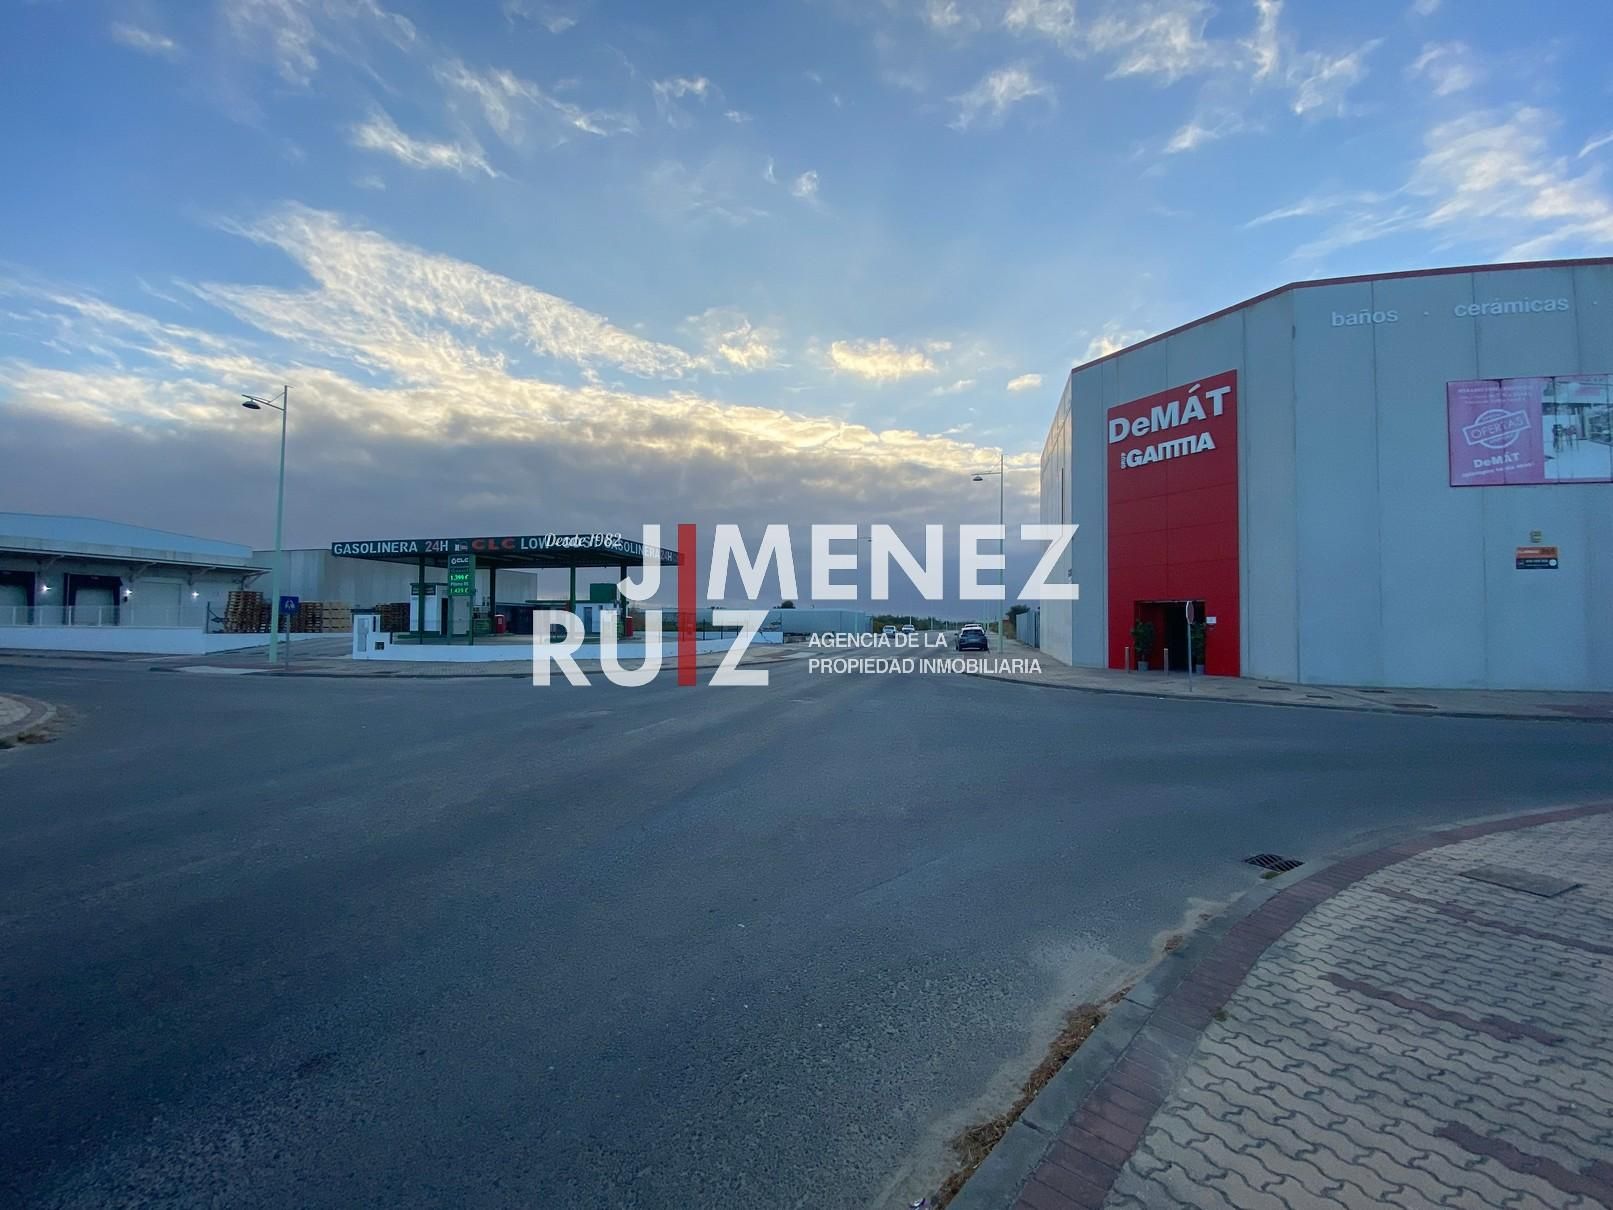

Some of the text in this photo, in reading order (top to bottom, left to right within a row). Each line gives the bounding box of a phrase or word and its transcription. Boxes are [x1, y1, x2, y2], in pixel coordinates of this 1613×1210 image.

[1331, 296, 1569, 327] baños cerámicas
[1109, 383, 1232, 443] DeMÁT
[1471, 415, 1524, 439] OFERTAS
[333, 541, 418, 555] GASOLINERA
[425, 540, 449, 552] 24H
[471, 538, 516, 551] CLC
[520, 537, 549, 550] LOW
